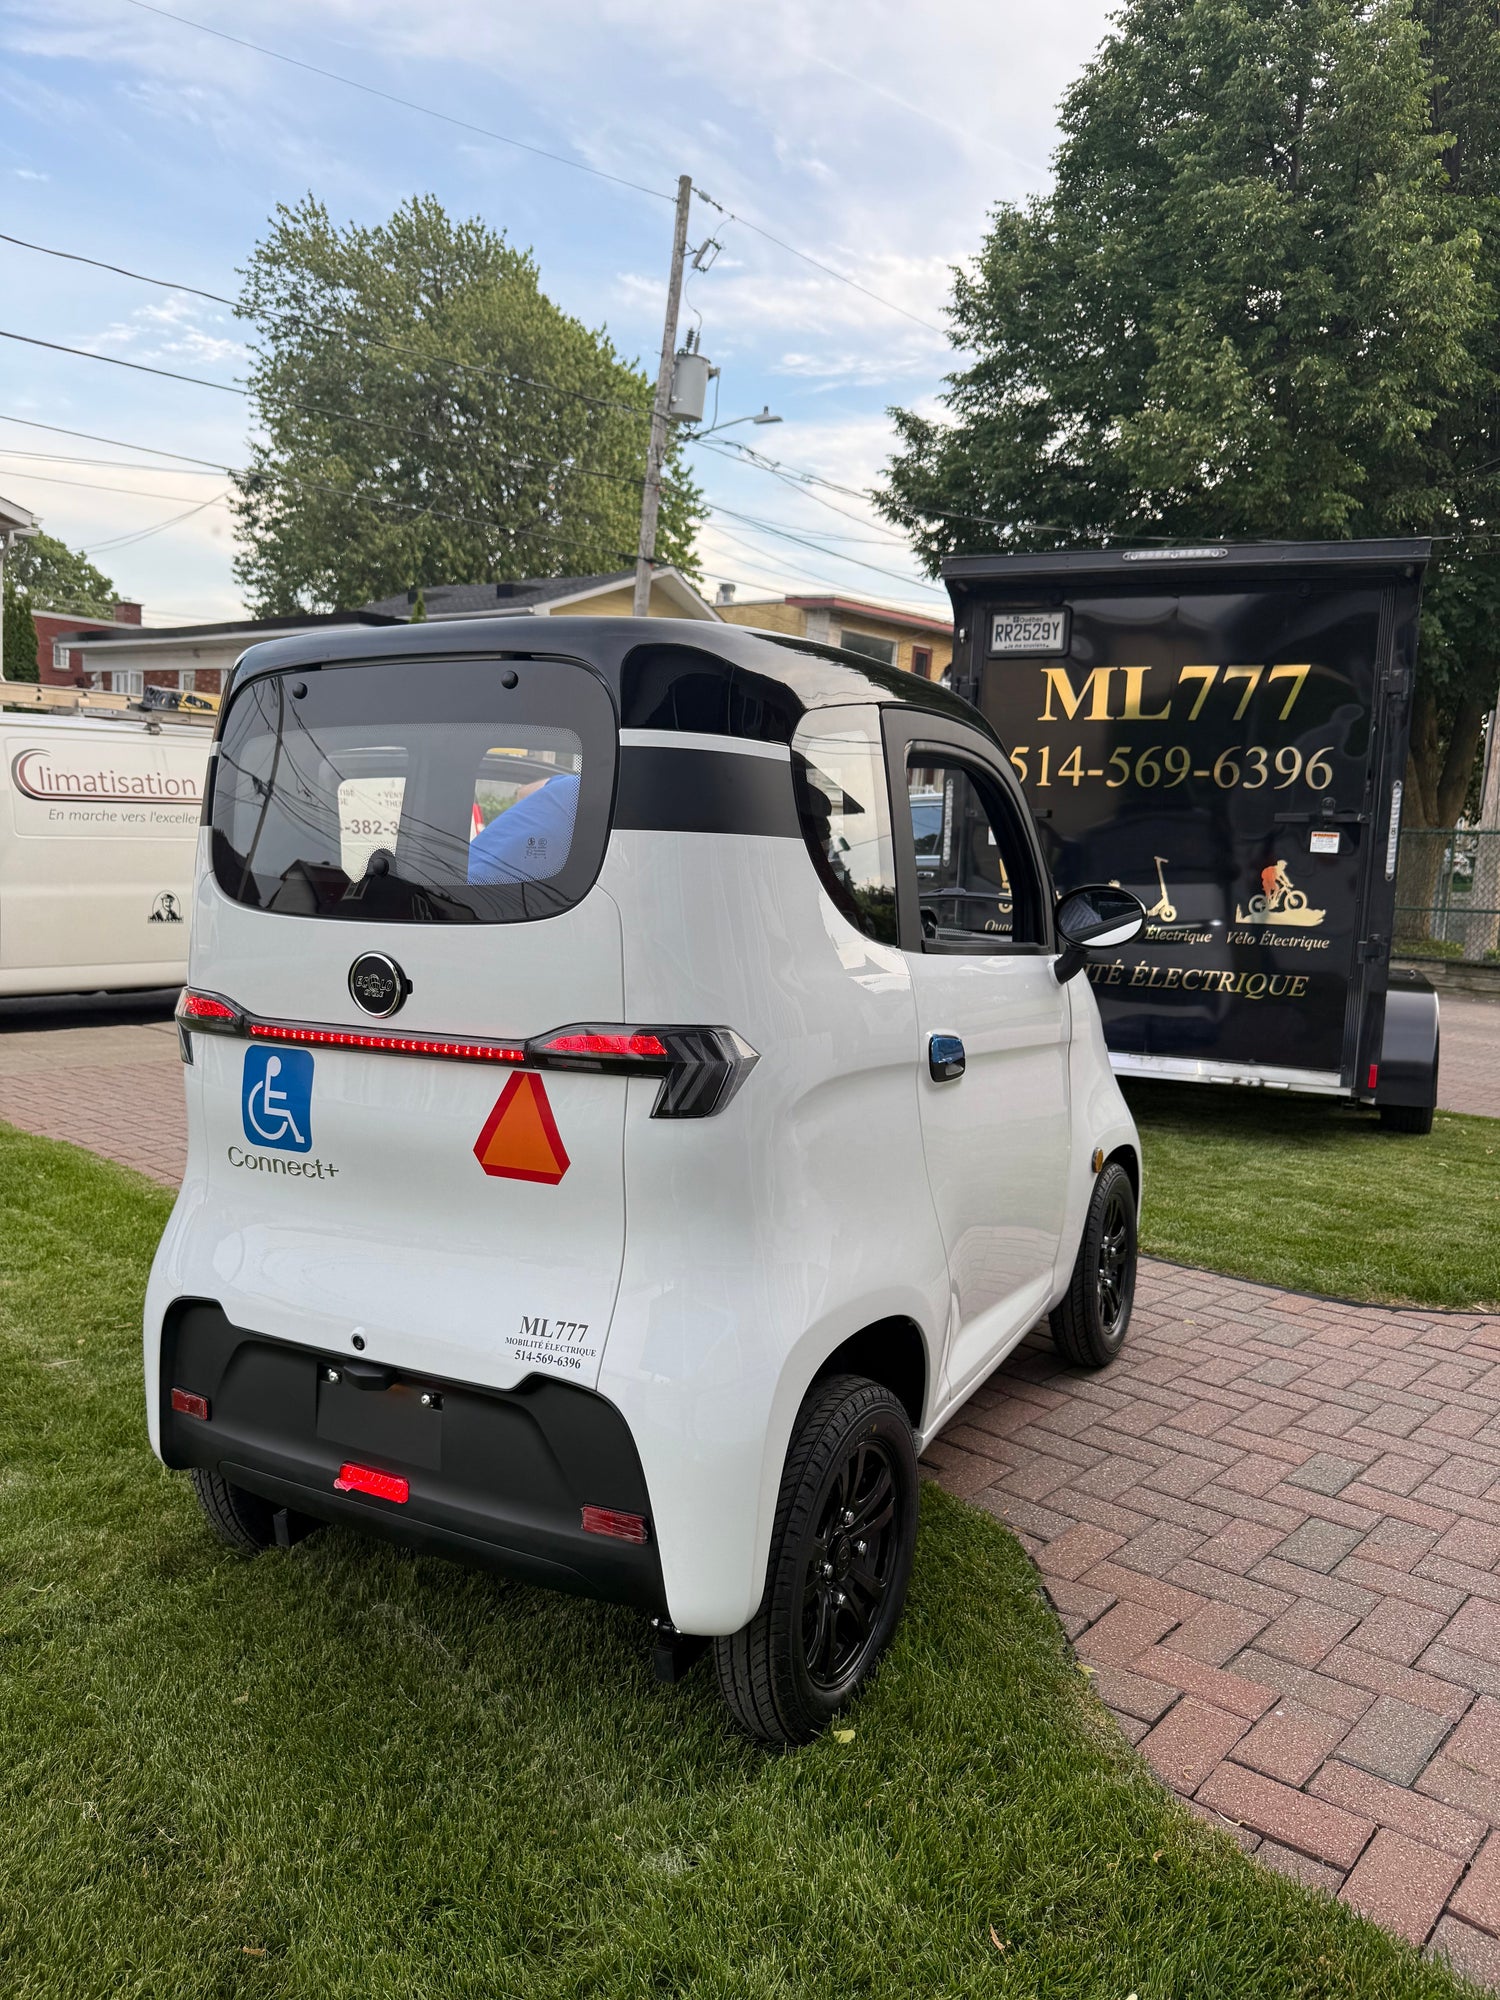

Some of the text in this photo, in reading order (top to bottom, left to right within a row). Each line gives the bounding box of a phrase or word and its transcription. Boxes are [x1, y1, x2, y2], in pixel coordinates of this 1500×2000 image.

[995, 622, 1060, 642] RR2529Y
[1037, 664, 1311, 722] ML777
[11, 748, 197, 800] Climatisation
[1010, 745, 1335, 790] 514-569-6396
[49, 808, 64, 820] En
[69, 810, 117, 821] marche
[121, 813, 146, 822] vers
[1145, 924, 1213, 945] Électrique
[1226, 930, 1330, 951] Vélo Électrique
[1128, 960, 1310, 1000] ÉLECTRIQUE
[228, 1146, 339, 1179] Connect+
[518, 1315, 589, 1343] ML777
[505, 1337, 597, 1358] MOBILITÉ ÉLECTRIQUE
[514, 1349, 582, 1370] 514-569-6396
